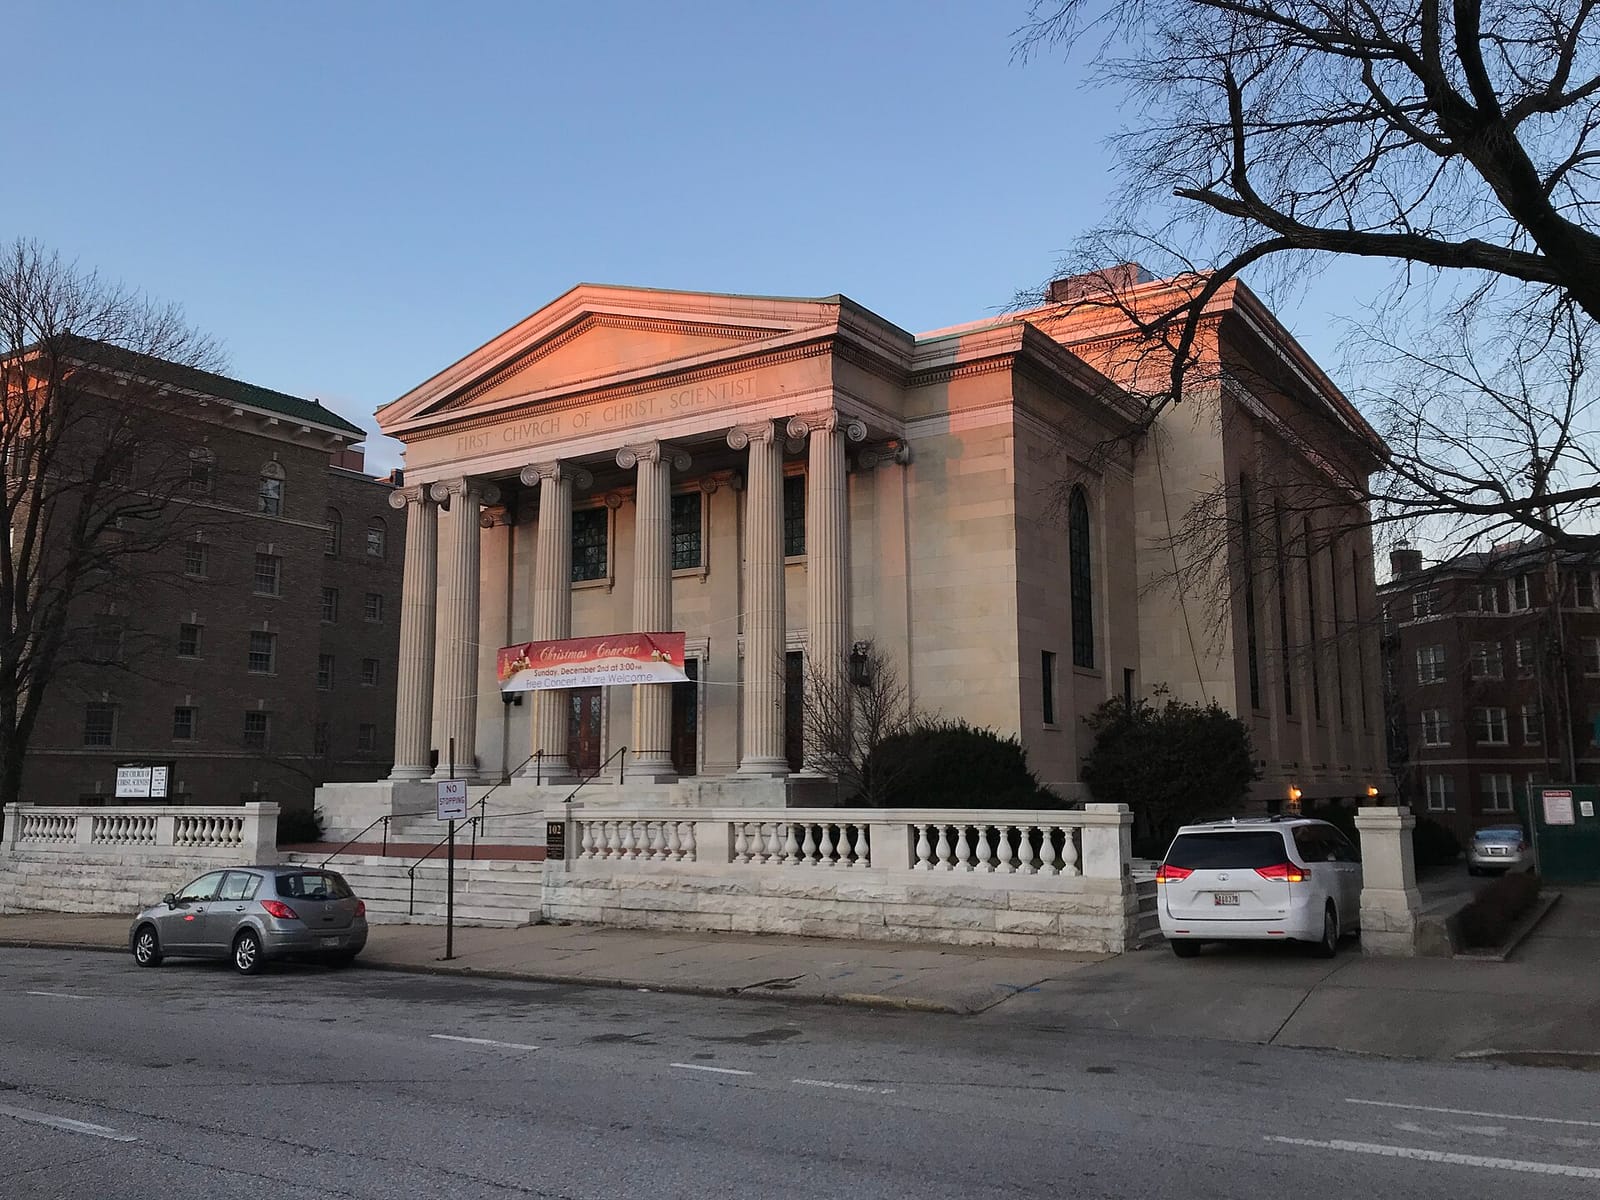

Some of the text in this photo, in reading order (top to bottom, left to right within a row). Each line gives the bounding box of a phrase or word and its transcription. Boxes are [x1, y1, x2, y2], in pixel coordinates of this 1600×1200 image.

[457, 431, 492, 451] FIRST
[572, 411, 592, 429] OF
[670, 376, 756, 409] SCIENTIST
[540, 641, 641, 665] Christmas Concert
[560, 664, 596, 675] December
[597, 664, 609, 672] 2nd
[526, 679, 542, 689] Free
[581, 675, 592, 684] All
[608, 672, 654, 683] Welcome
[446, 784, 458, 793] NO
[439, 796, 465, 805] STOPPING
[548, 824, 562, 835] 102
